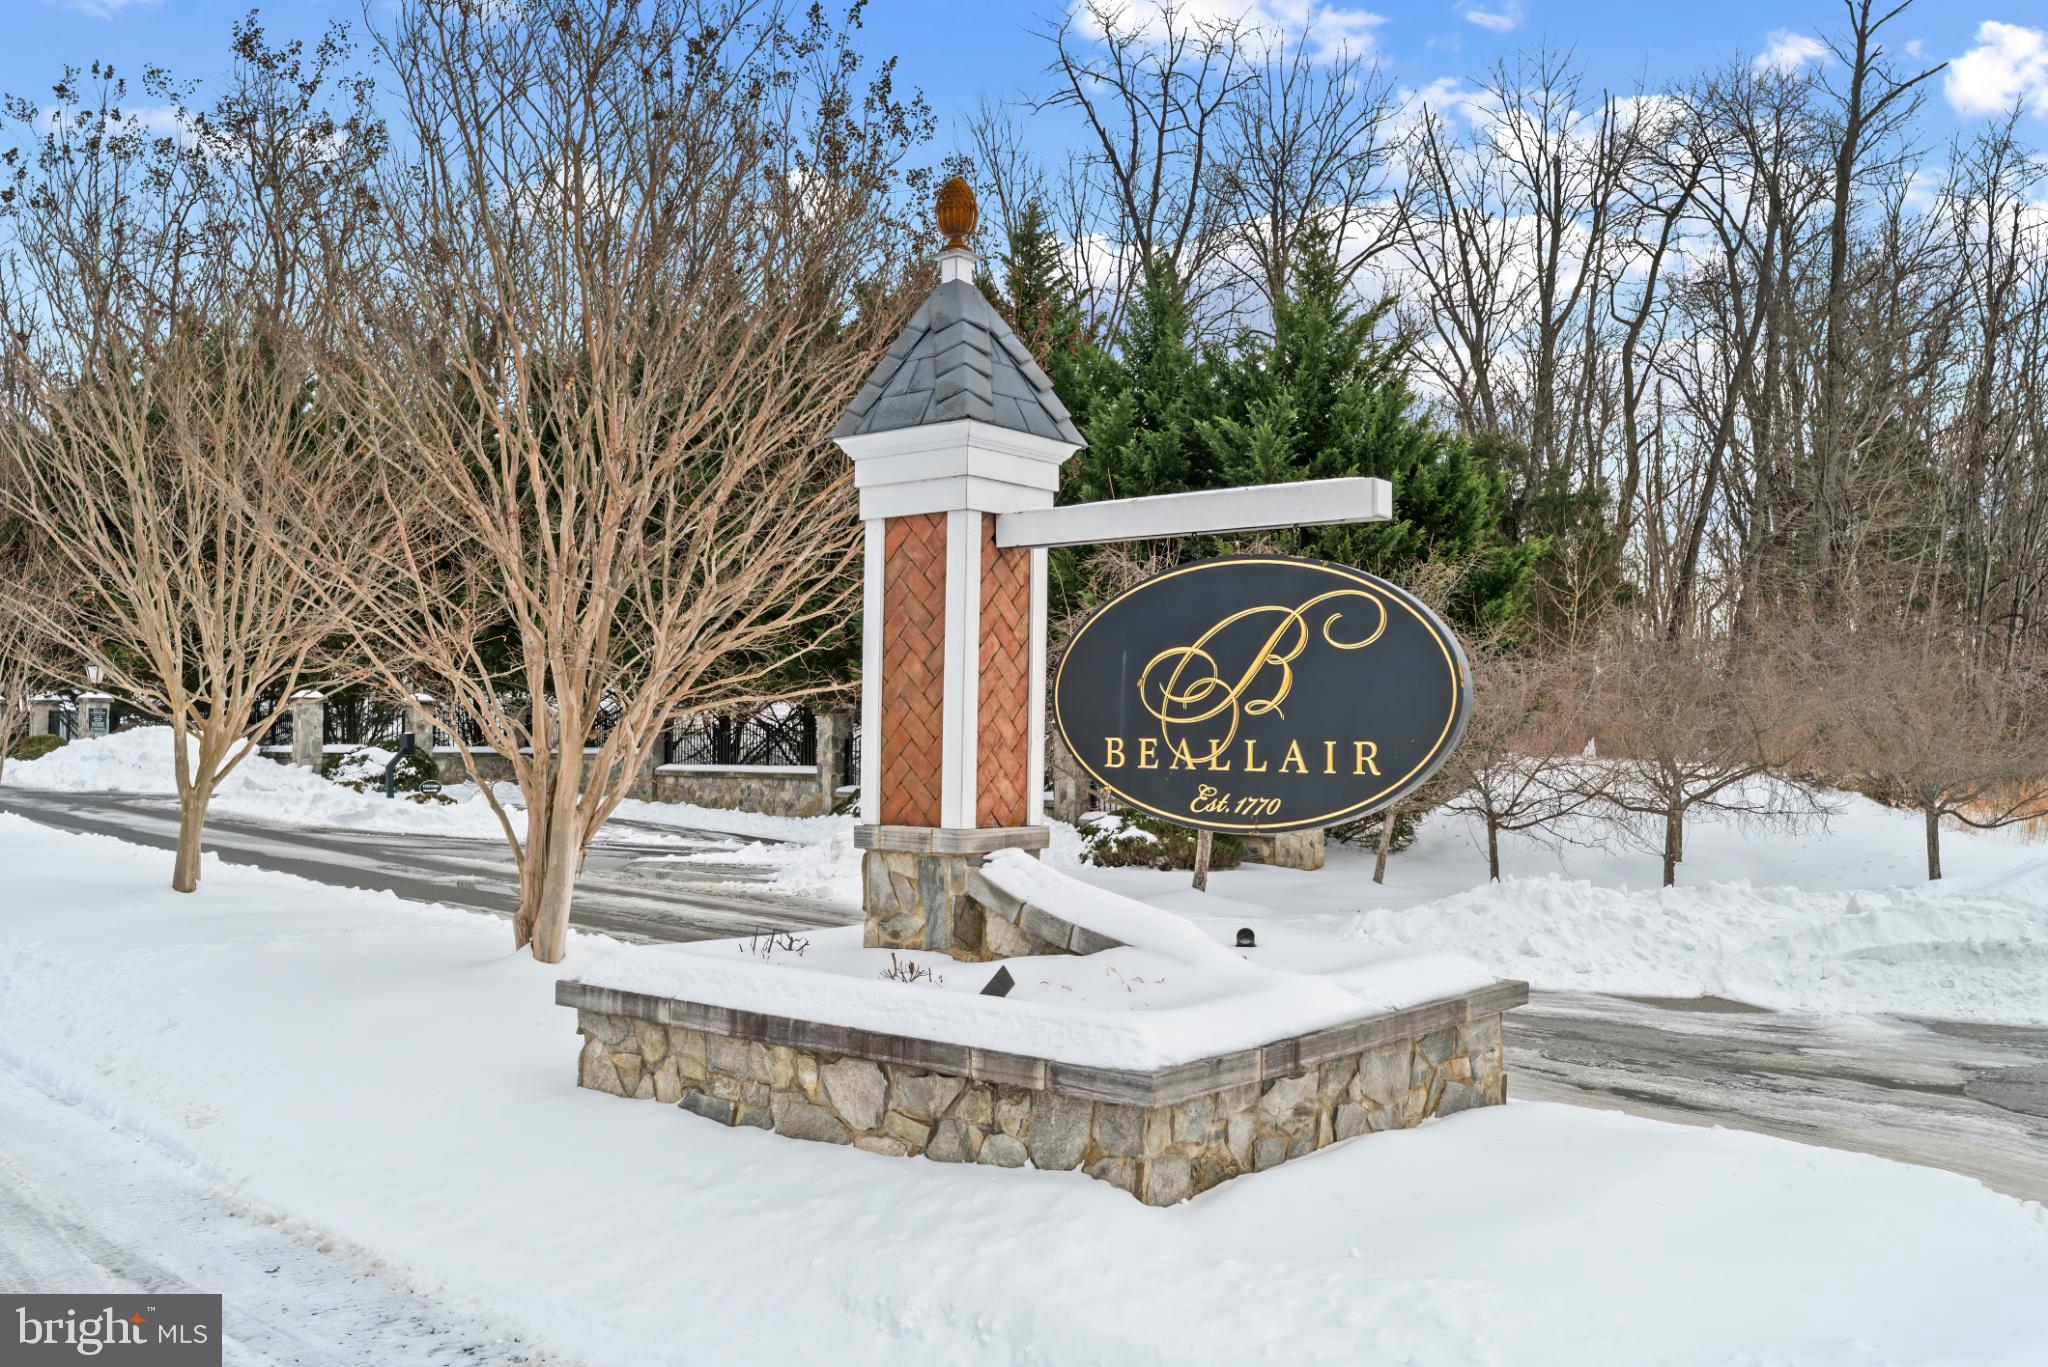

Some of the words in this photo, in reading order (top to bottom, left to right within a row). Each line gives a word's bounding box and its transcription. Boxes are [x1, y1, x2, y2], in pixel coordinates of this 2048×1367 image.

[1138, 590, 1387, 762] B
[1104, 737, 1382, 776] BEALLAIR
[1190, 783, 1231, 813] Est.
[1234, 796, 1282, 816] 1770
